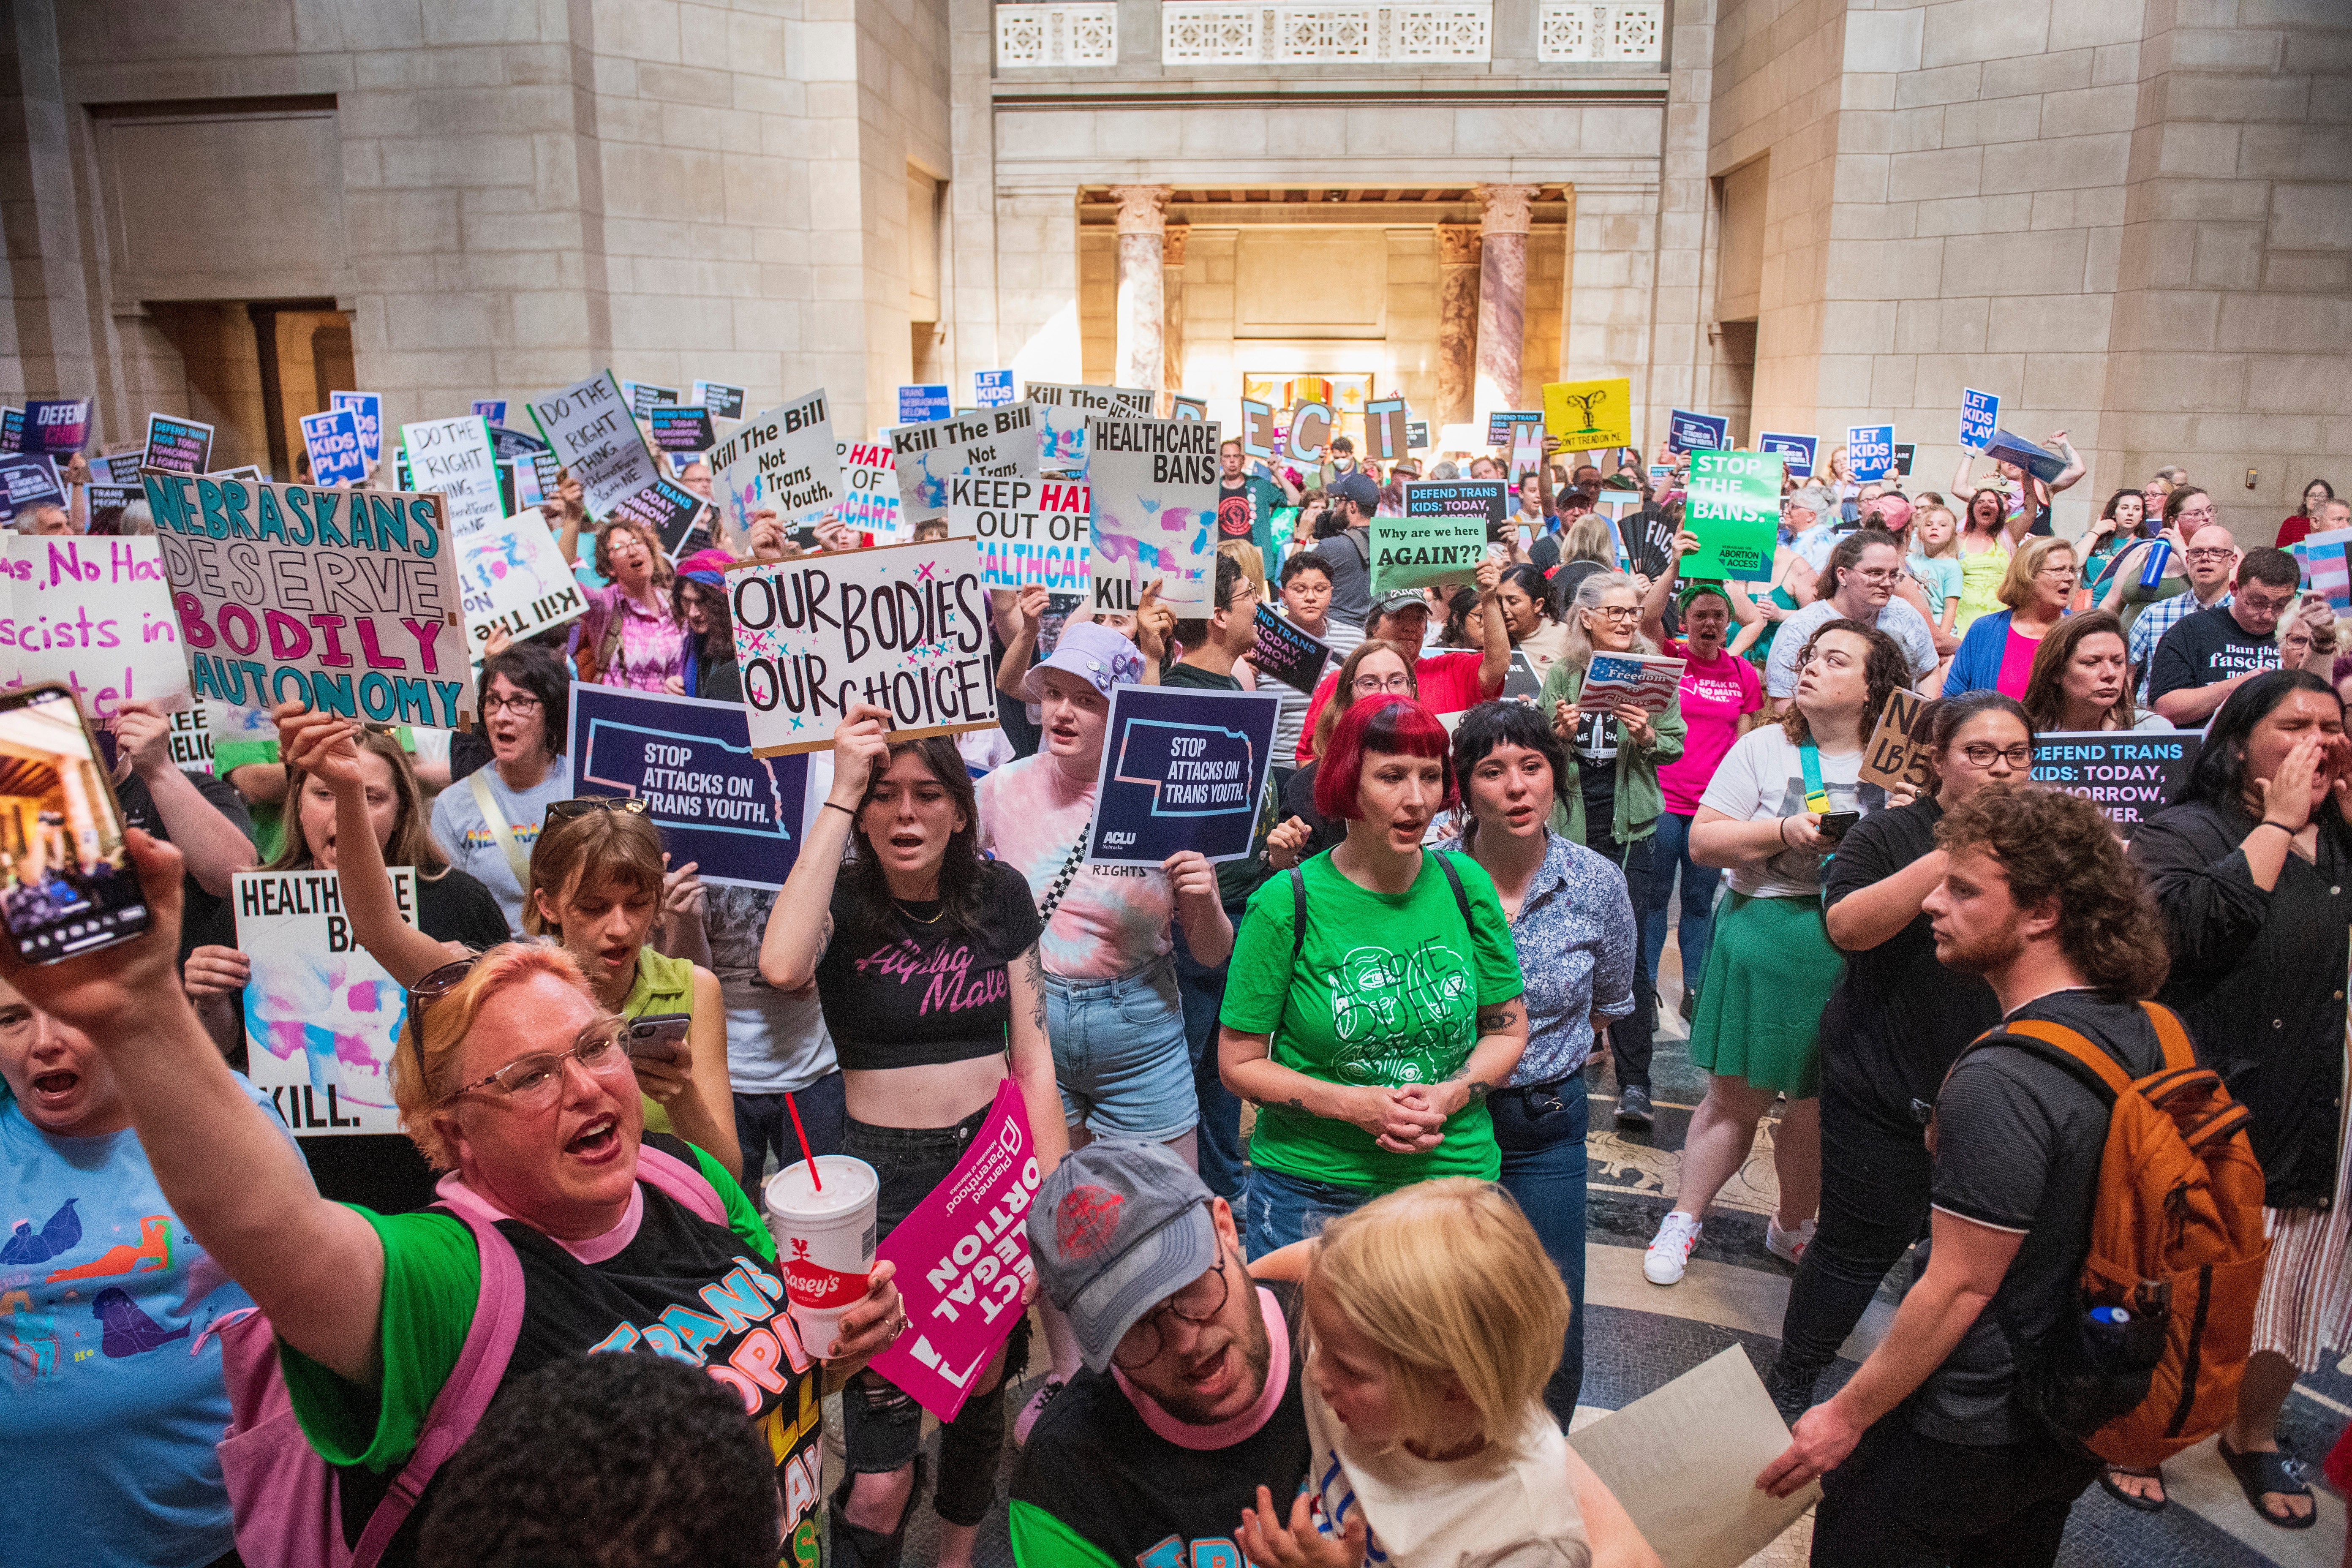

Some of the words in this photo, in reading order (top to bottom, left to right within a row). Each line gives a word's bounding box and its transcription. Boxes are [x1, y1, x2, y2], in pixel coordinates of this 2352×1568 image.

[977, 373, 1001, 385] LET
[539, 398, 569, 426] DO
[570, 380, 612, 414] THE
[977, 386, 1011, 399] KIDS
[1026, 385, 1062, 405] Kill
[1069, 389, 1108, 410] The
[1966, 392, 1988, 409] LET
[306, 417, 338, 439] LET
[1964, 408, 1993, 425] KIDS
[414, 425, 441, 449] DO
[442, 420, 479, 442] THE
[566, 409, 617, 454] RIGHT
[709, 439, 737, 476] Kill
[740, 423, 779, 453] The
[784, 398, 825, 434] Bill
[894, 427, 938, 455] Kill
[943, 420, 988, 445] The
[994, 406, 1031, 434] Bill
[1097, 422, 1217, 455] HEALTHCARE
[1562, 437, 1576, 446] ONT
[1578, 435, 1600, 445] TREAD
[1599, 434, 1610, 444] ON
[1612, 432, 1622, 442] ME
[1851, 429, 1879, 444] LET
[1962, 421, 1994, 439] PLAY
[309, 432, 356, 456] KIDS
[849, 444, 896, 470] HAT
[967, 445, 996, 465] Not
[1851, 444, 1890, 457] KIDS
[315, 449, 362, 475] PLAY
[425, 448, 482, 479] RIGHT
[759, 448, 786, 474] Not
[1154, 455, 1216, 485] BANS
[1697, 456, 1761, 475] STOP
[1851, 457, 1891, 471] PLAY
[767, 465, 811, 493] Trans
[852, 469, 885, 490] OF
[1695, 477, 1742, 495] THE
[641, 489, 676, 517] ODAY,
[656, 481, 692, 509] TRANS
[781, 481, 833, 511] Youth.
[953, 478, 1031, 509] KEEP
[1039, 484, 1090, 513] HAT
[1411, 488, 1457, 500] DEFEND
[1459, 487, 1497, 498] TRANS
[1411, 501, 1443, 512] KIDS:
[1445, 500, 1490, 512] TODAY,
[143, 474, 440, 558] NEBRASKANS
[1693, 500, 1765, 523] BANS.
[977, 512, 1040, 539] OUT
[1048, 515, 1090, 542] OF
[1379, 528, 1407, 541] Why
[1411, 528, 1430, 537] are
[1454, 526, 1479, 536] here
[48, 541, 101, 586] No
[1377, 544, 1481, 566] AGAIN??
[1719, 549, 1759, 559] ABORTION
[1726, 558, 1759, 568] ACCESS
[159, 532, 444, 618] DESERVE
[531, 587, 581, 623] Kill
[1095, 577, 1149, 610] KIL
[0, 605, 120, 652] scists
[142, 612, 175, 643] in
[733, 569, 842, 633] OUR
[840, 573, 983, 664] BODIES
[174, 591, 444, 674] BODILY
[1259, 624, 1301, 660] TODAY,
[1277, 623, 1316, 654] TRANS
[1117, 655, 1126, 665] SHE
[1257, 639, 1297, 670] RROW,
[2225, 644, 2255, 655] Ban
[1608, 669, 1667, 683] Freedom
[1626, 685, 1639, 693] to
[1699, 679, 1728, 689] SPEAK
[193, 651, 463, 728] AUTONOMY
[745, 653, 839, 717] OUR
[838, 654, 995, 732] CHOICE!
[1605, 693, 1651, 705] Choose
[1699, 687, 1712, 695] NO
[644, 742, 692, 768] STOP
[1170, 736, 1206, 757] STOP
[2110, 743, 2183, 760] TRANS
[642, 767, 723, 795] ATTACKS
[727, 776, 754, 798] ON
[1167, 761, 1223, 781] ATTACKS
[1224, 761, 1240, 780] ON
[2082, 765, 2166, 782] TODAY,
[1165, 784, 1207, 803] TRANS
[1211, 783, 1244, 802] YOUTH.
[641, 789, 702, 816] TRANS
[706, 798, 770, 825] YOUTH.
[1102, 831, 1136, 845] ACLU
[1092, 864, 1147, 878] RIGHTS
[240, 873, 411, 917] HEALTHE
[855, 937, 975, 984] Alpha
[1378, 935, 1448, 989] LOVE
[919, 969, 1009, 1017] Male
[1333, 969, 1473, 1043] QUEER
[975, 1139, 999, 1167] Advocates
[945, 1146, 1005, 1217] Parenthood
[972, 1154, 1014, 1205] Planned
[926, 1164, 1042, 1294] ORTION
[782, 1265, 841, 1299] Casey's
